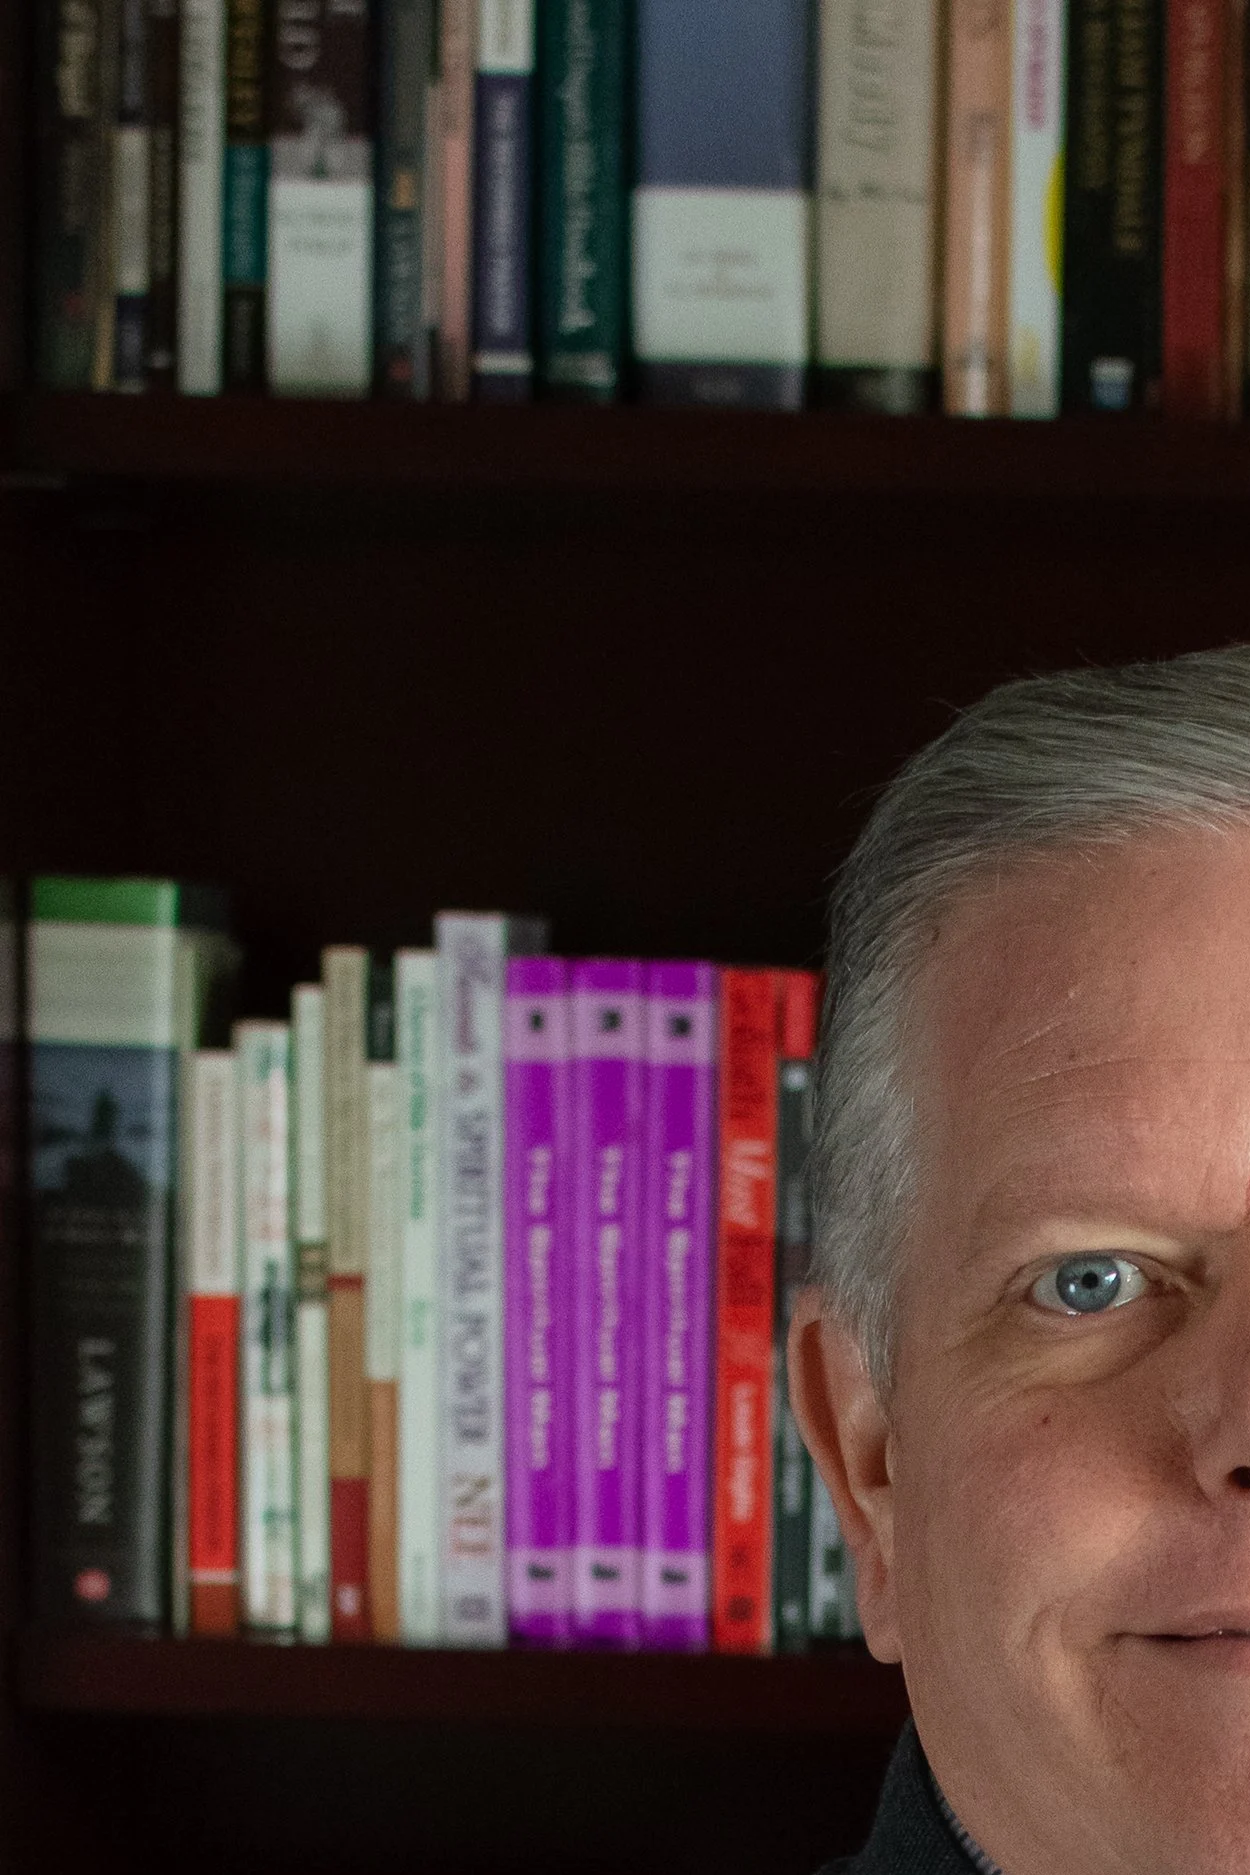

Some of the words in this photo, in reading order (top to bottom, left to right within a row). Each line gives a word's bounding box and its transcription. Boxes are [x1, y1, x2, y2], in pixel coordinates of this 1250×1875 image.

[450, 1110, 487, 1300] SPIRITUAL
[526, 1145, 551, 1214] The
[596, 1145, 621, 1214] The
[665, 1151, 691, 1218] The
[725, 1135, 769, 1229] Must
[523, 1225, 551, 1381] Spiritual
[593, 1225, 621, 1381] Spiritual
[661, 1229, 691, 1385] Spiritual
[451, 1312, 489, 1444] POWER
[77, 1336, 115, 1525] LAWSON
[526, 1390, 551, 1469] Man
[595, 1390, 621, 1469] Man
[663, 1395, 691, 1474] Man
[450, 1474, 493, 1562] NEE
